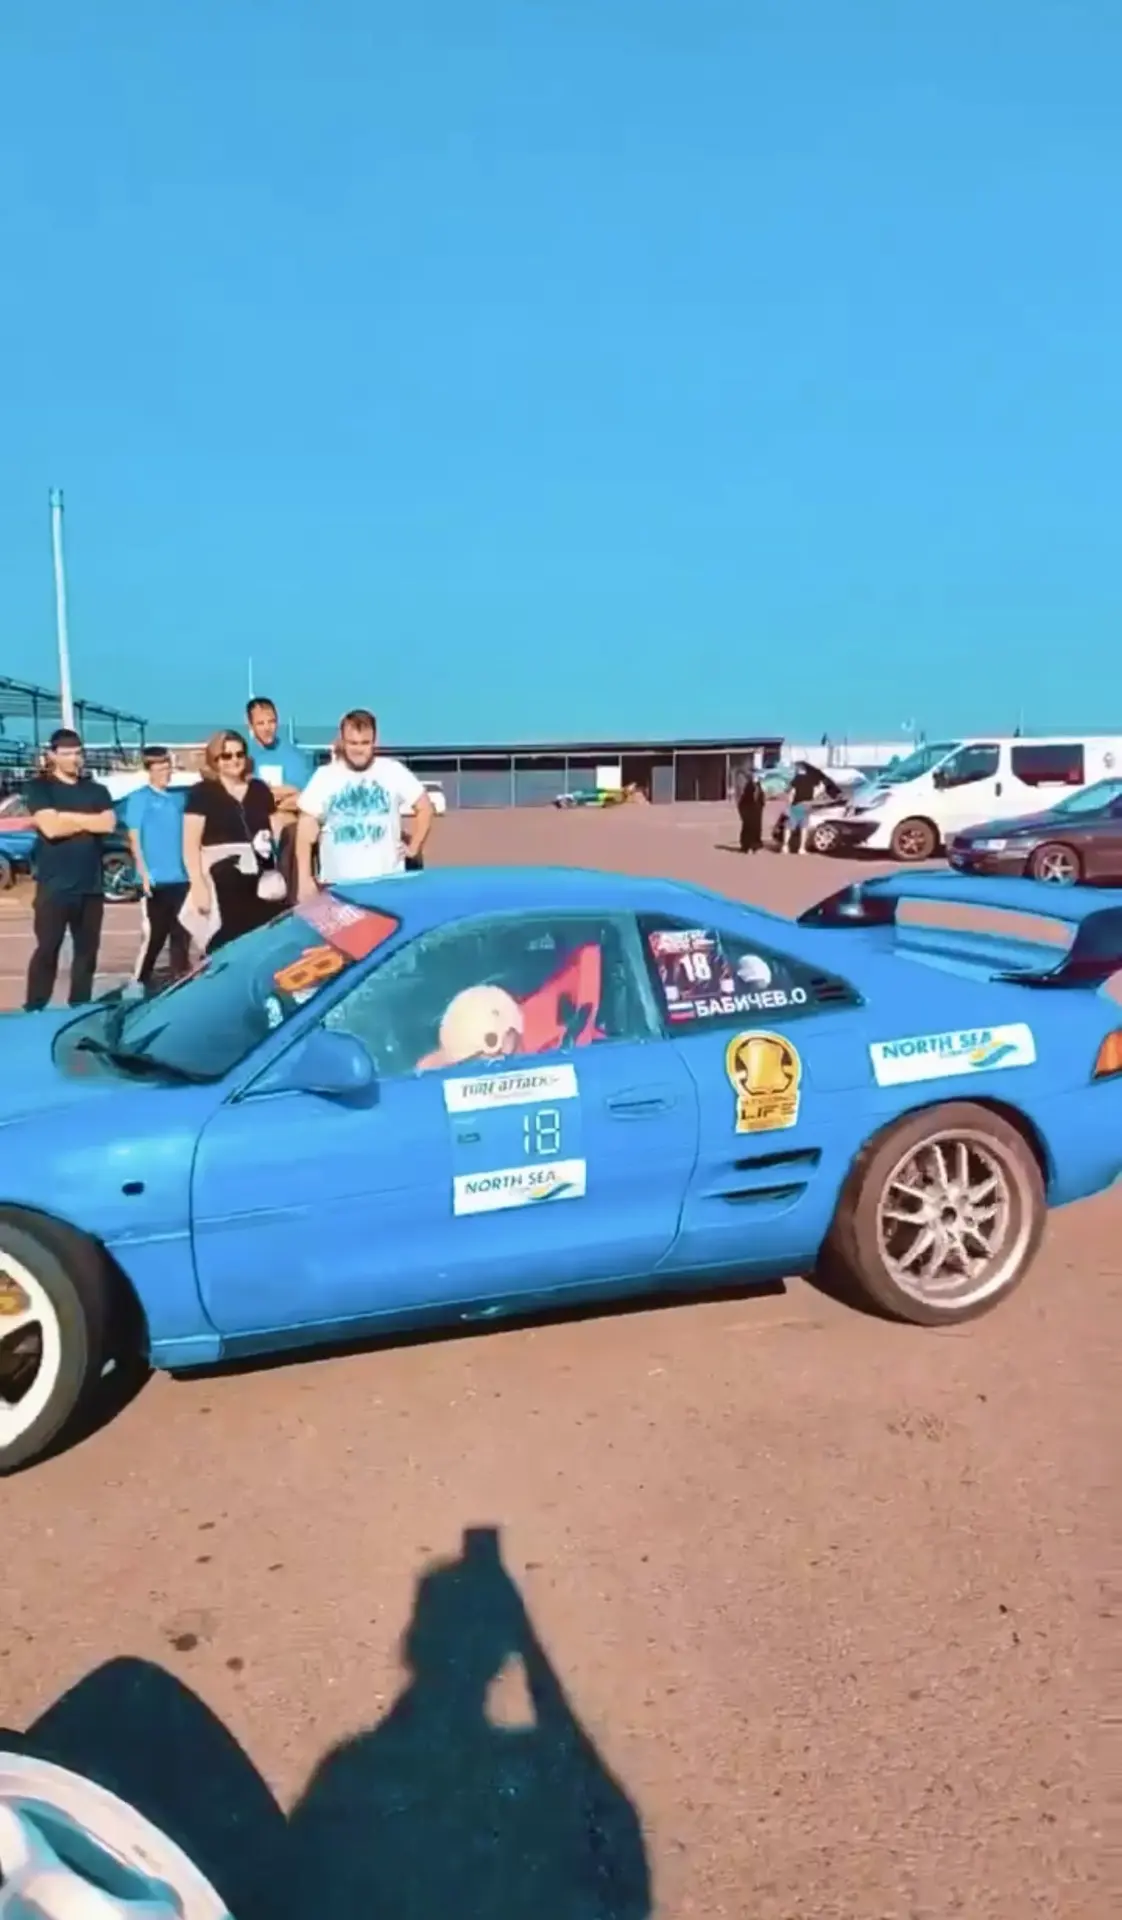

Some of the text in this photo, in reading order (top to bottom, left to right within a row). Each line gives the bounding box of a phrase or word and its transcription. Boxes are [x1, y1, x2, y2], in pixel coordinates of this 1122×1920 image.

[679, 952, 712, 982] 18
[695, 987, 807, 1018] БАБИЧЕВ.О
[882, 1031, 992, 1059] NORTH SEA
[523, 1108, 561, 1155] 18
[464, 1173, 523, 1195] NORTH
[528, 1169, 557, 1186] SEA
